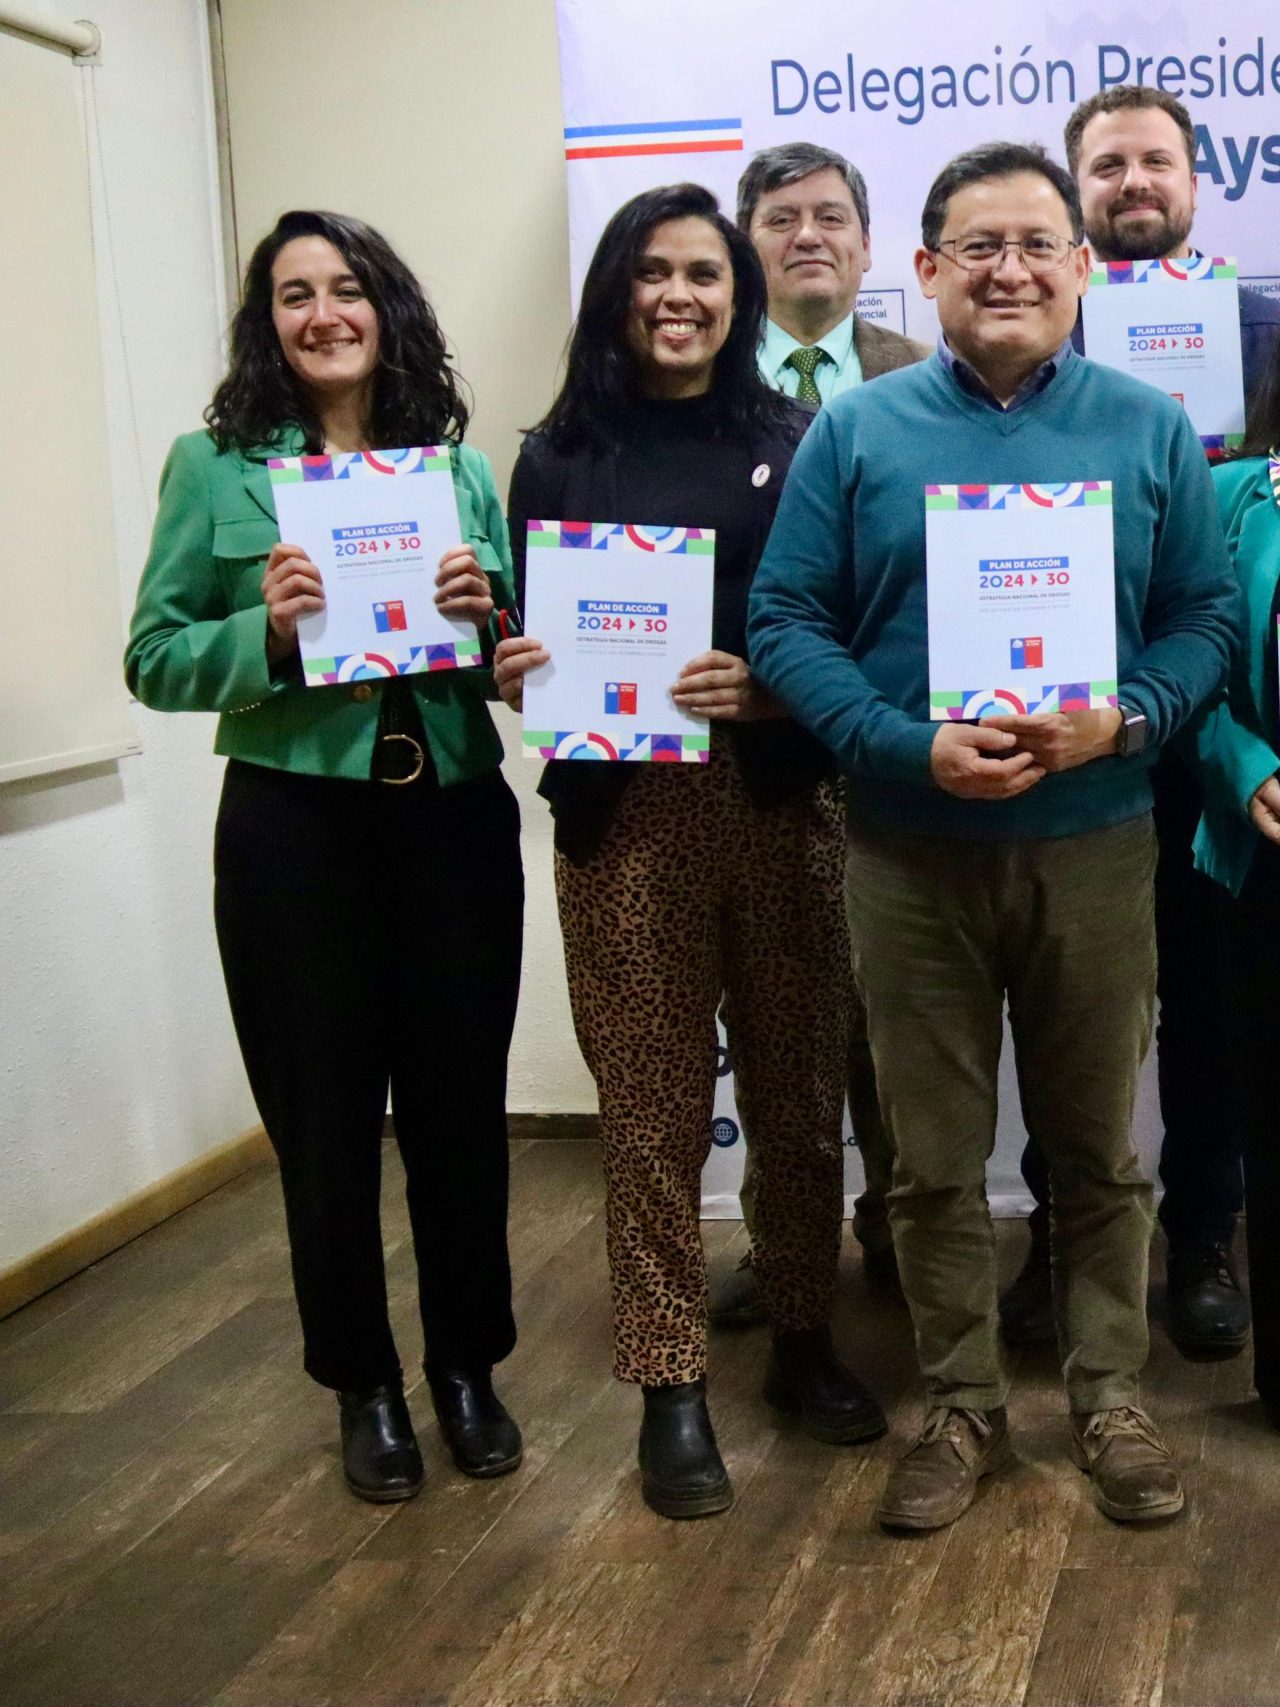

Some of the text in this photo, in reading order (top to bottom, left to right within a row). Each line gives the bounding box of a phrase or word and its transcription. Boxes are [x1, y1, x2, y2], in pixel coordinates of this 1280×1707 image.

[771, 45, 1076, 125] Delegación
[1136, 325, 1196, 335] PLAN DE ACCIÓN
[1129, 337, 1204, 351] 2024 30
[341, 524, 411, 537] PLAN DE ACCIÓN
[335, 536, 421, 556] 2024 30
[989, 559, 1061, 570] PLAN DE ACCIÓN
[979, 572, 1070, 588] 2024 30
[588, 603, 659, 613] PLAN DE ACCIÓN
[577, 616, 667, 632] 2024 30
